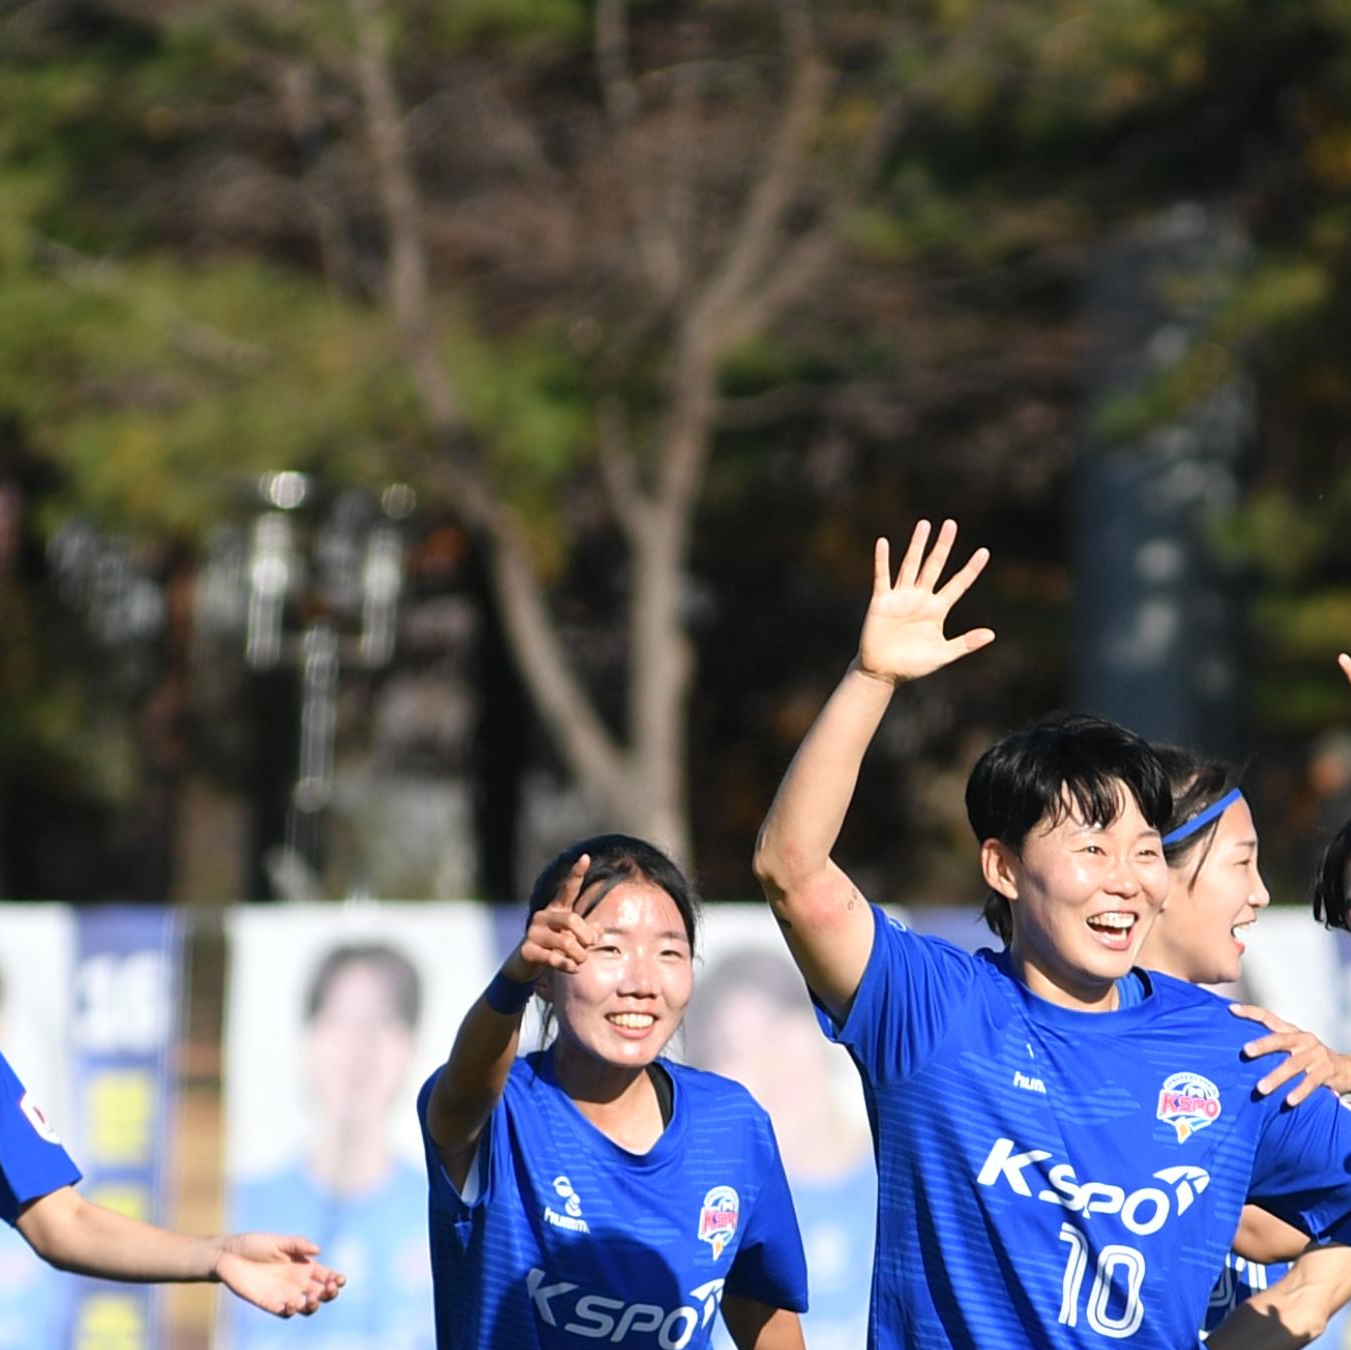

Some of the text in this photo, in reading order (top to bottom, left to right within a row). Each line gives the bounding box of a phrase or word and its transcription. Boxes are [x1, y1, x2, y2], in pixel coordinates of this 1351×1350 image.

[977, 1137, 1171, 1236] KSPO
[526, 1268, 699, 1350] KSPO
[1058, 1222, 1146, 1339] 10
